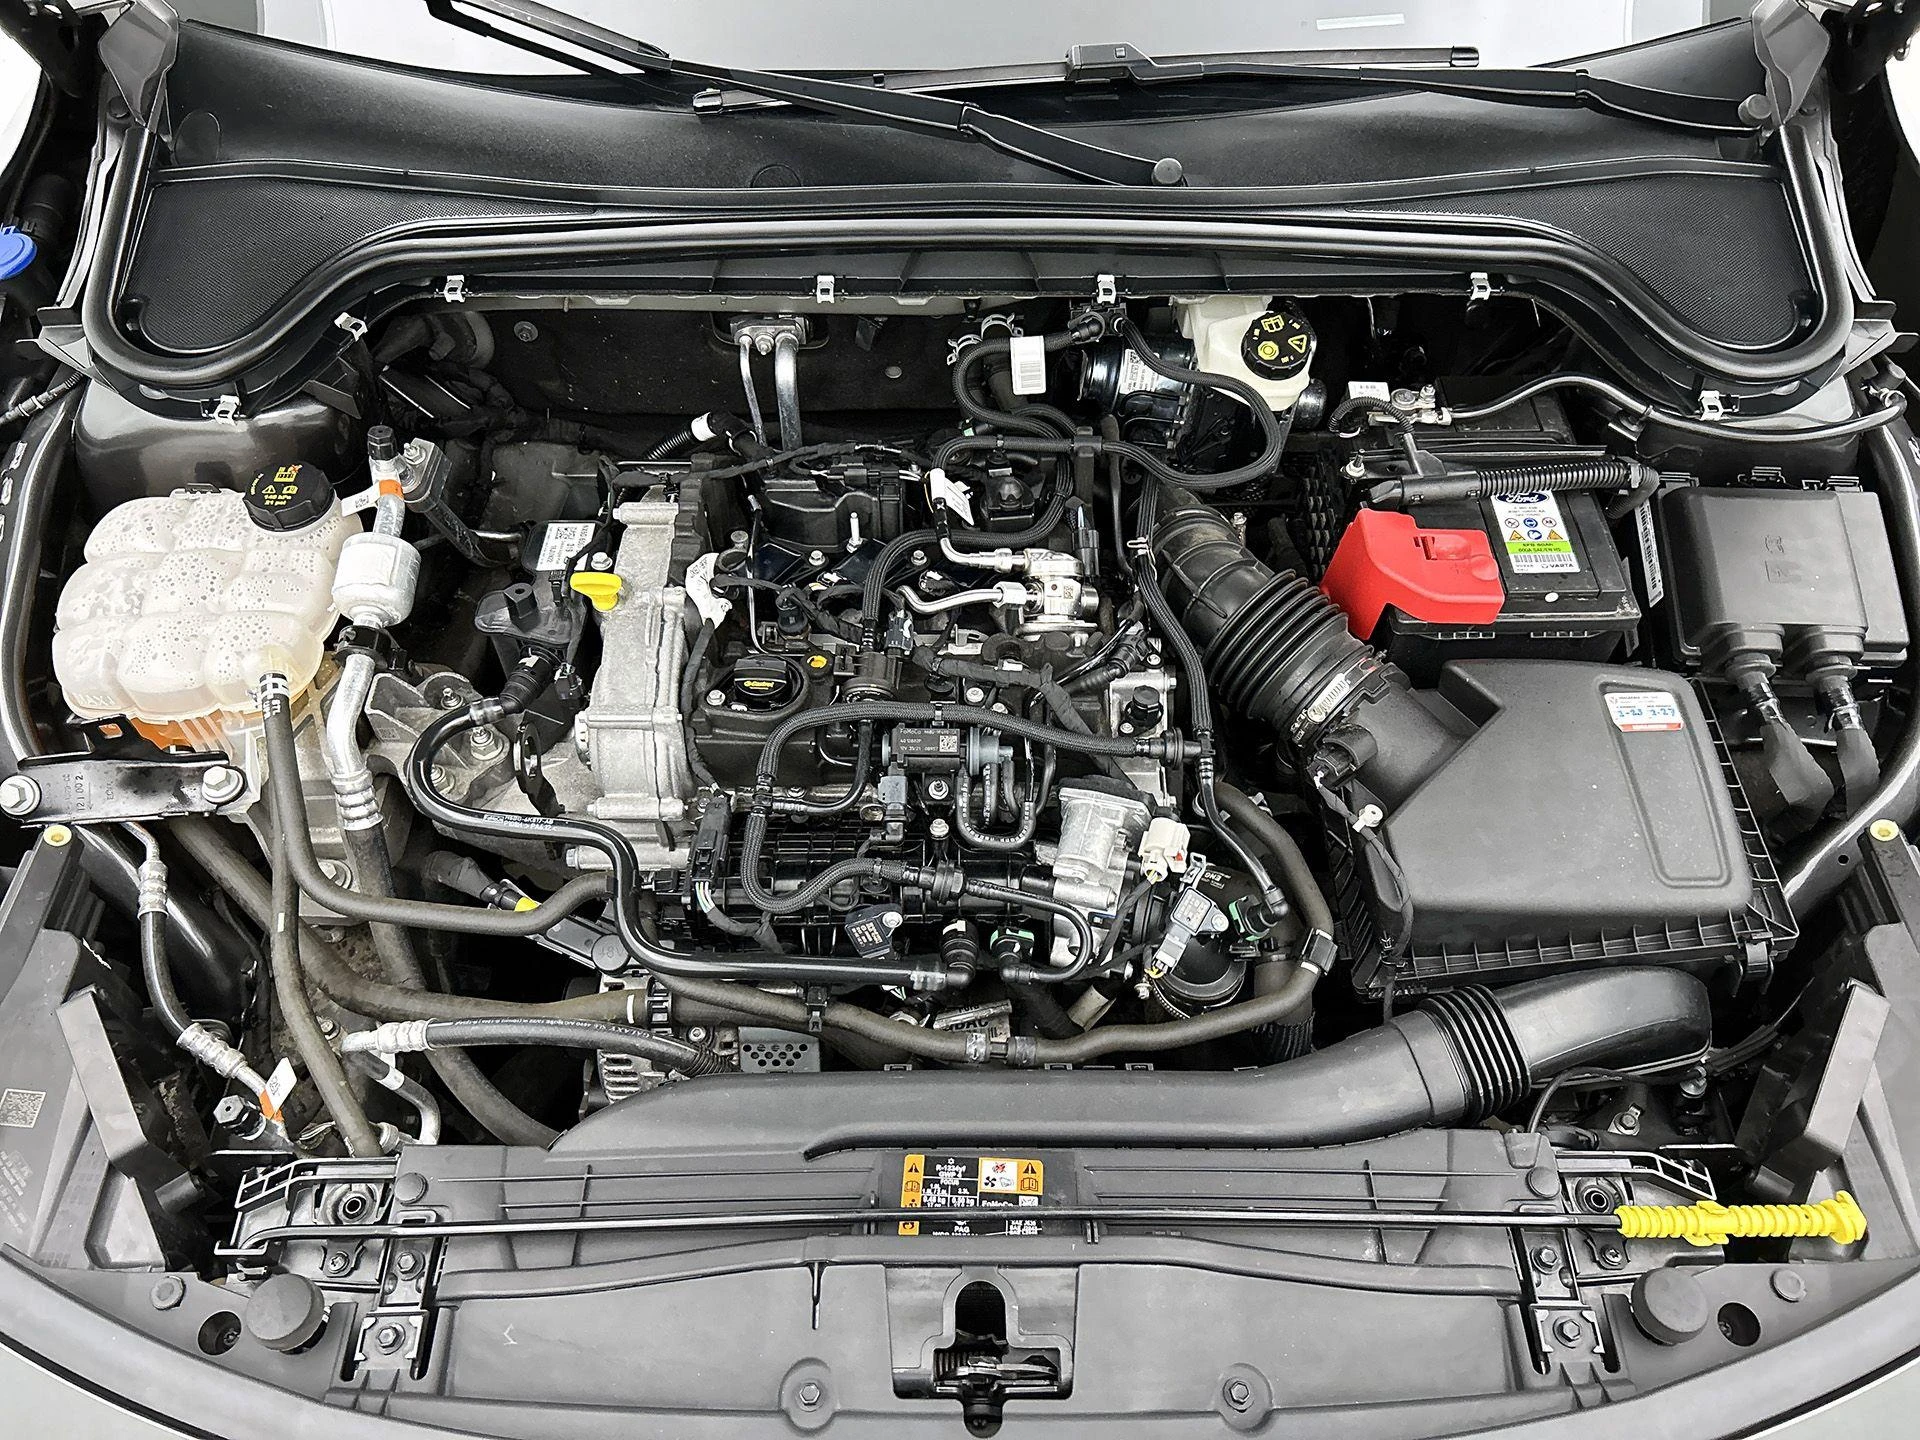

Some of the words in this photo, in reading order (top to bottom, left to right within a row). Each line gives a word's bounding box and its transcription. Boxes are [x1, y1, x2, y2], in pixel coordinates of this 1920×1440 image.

[1506, 492, 1539, 503] Ford
[610, 1025, 650, 1039] GALAXY
[935, 1164, 966, 1172] R-1234yf
